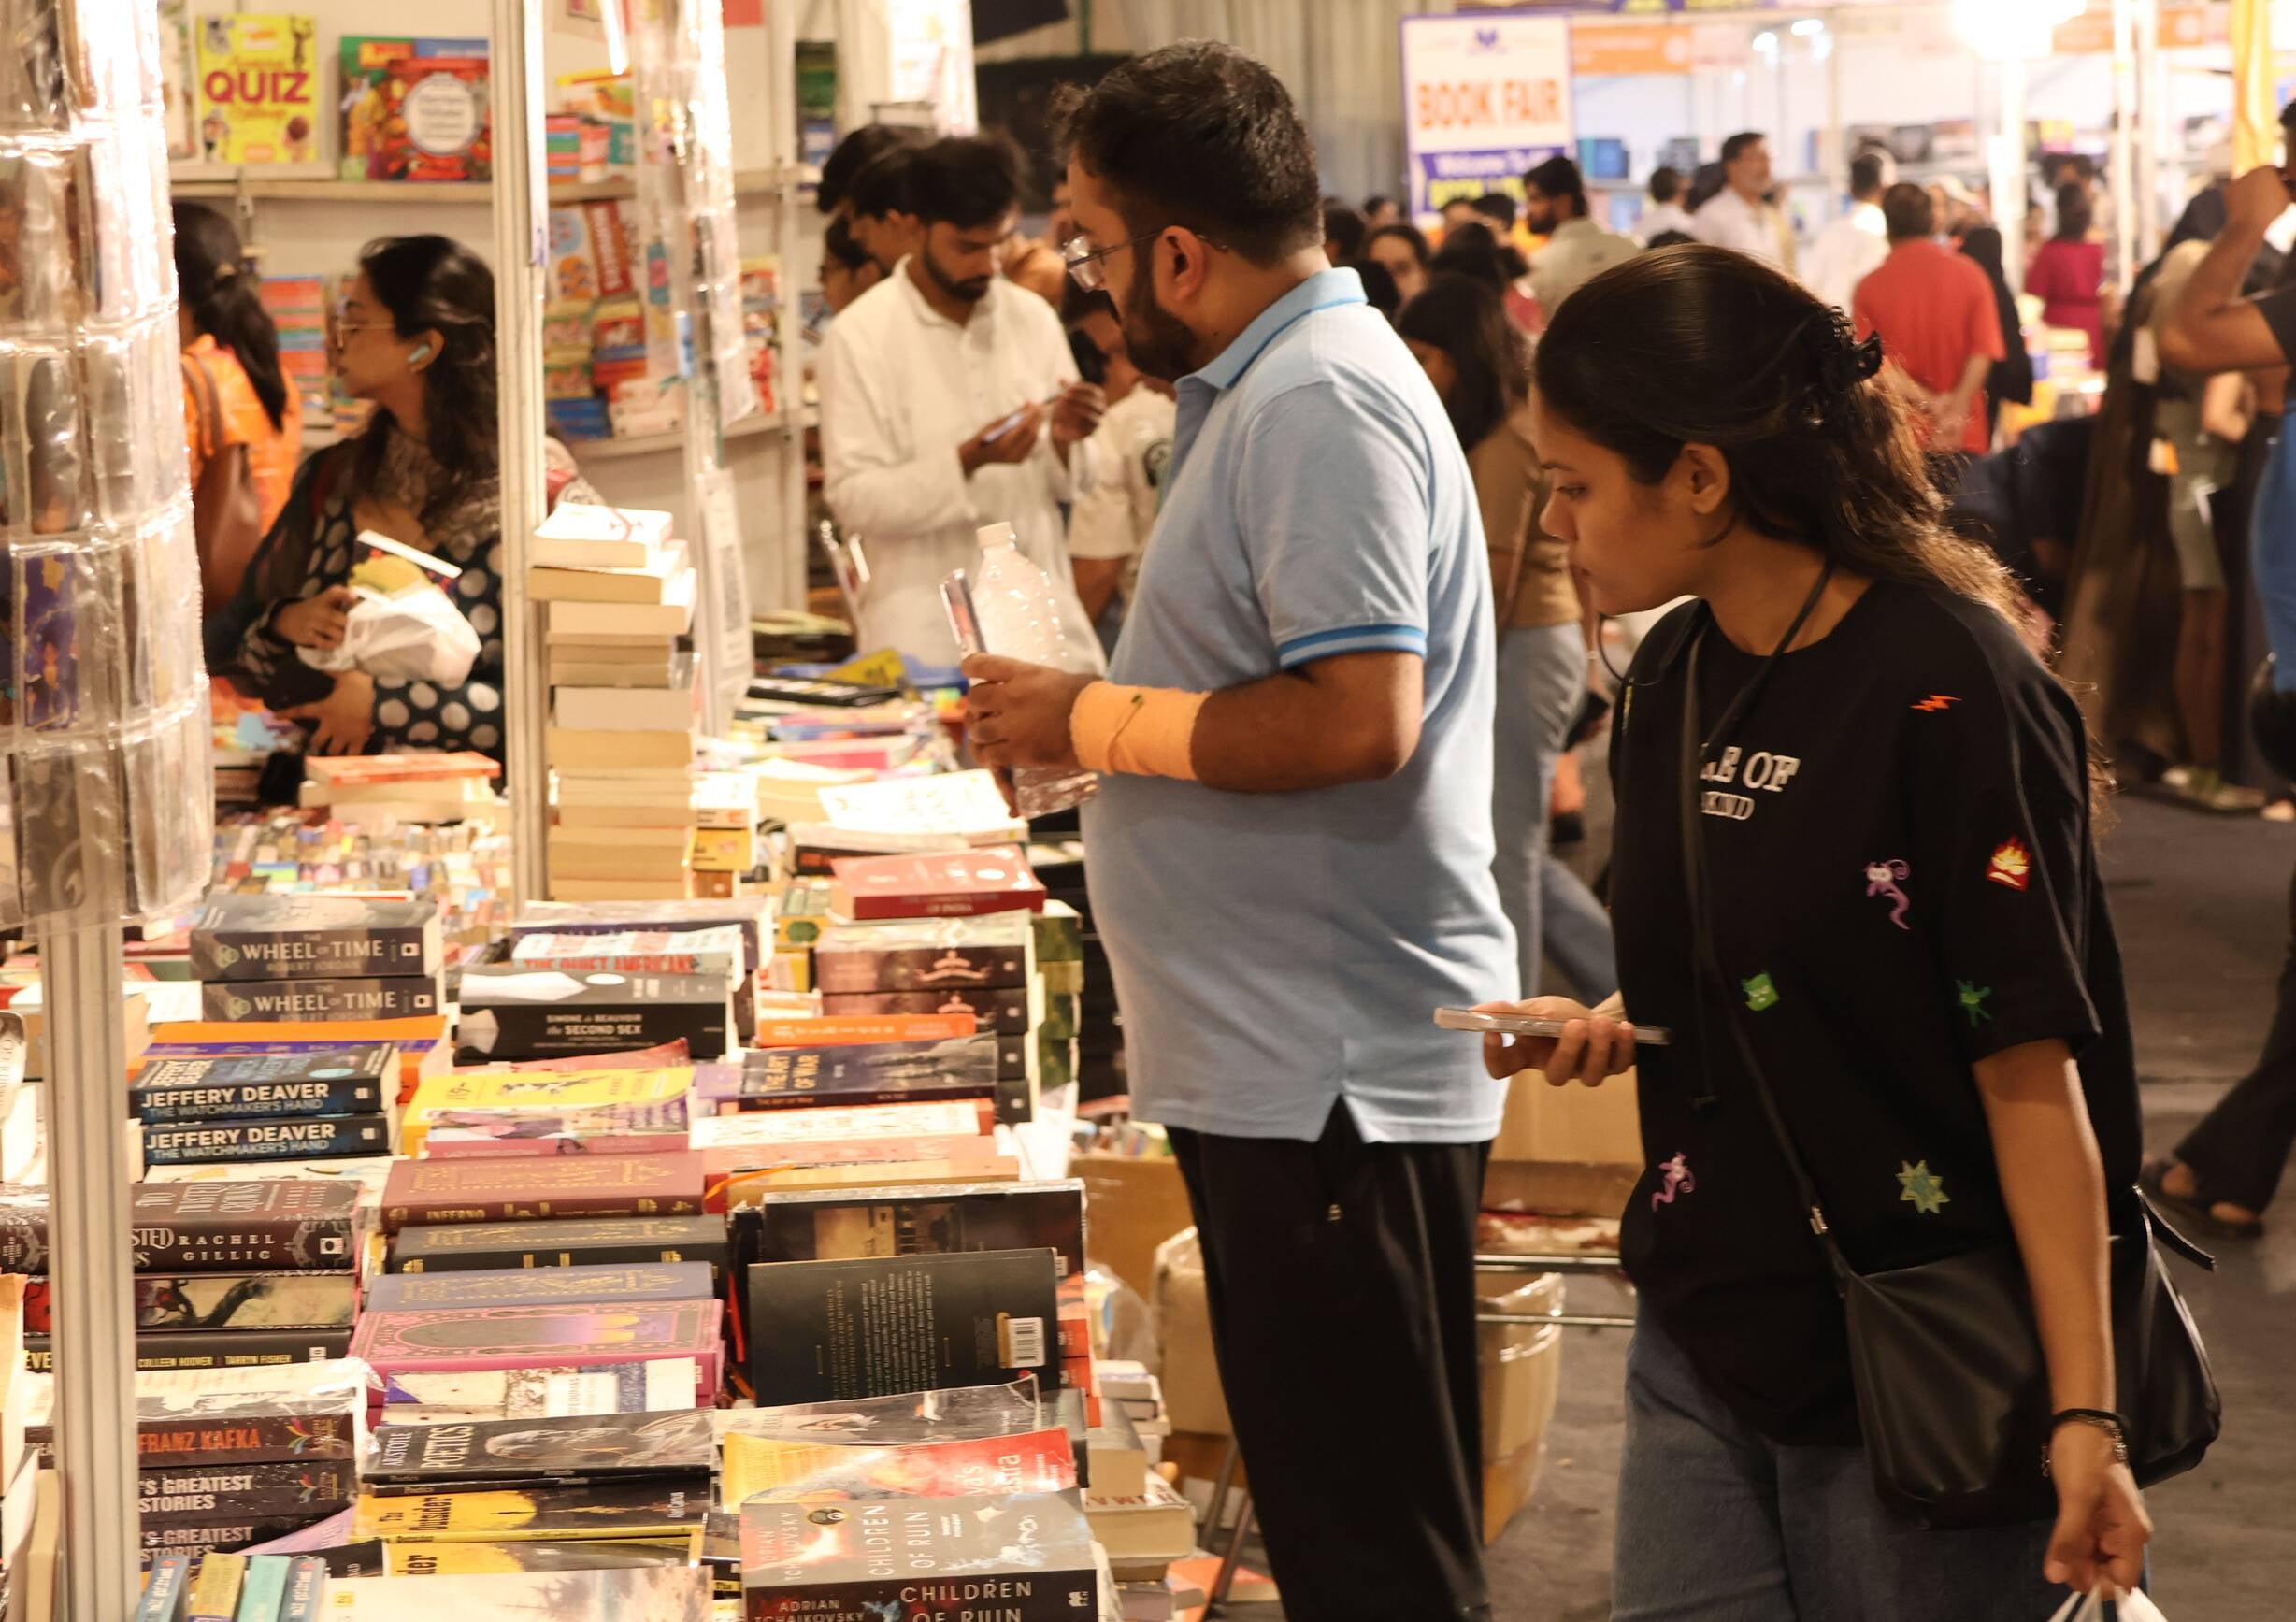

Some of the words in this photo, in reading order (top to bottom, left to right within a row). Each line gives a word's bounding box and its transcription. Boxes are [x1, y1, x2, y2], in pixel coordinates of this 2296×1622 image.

[205, 70, 310, 104] QUIZ
[1417, 81, 1494, 129] BOOK
[1502, 79, 1561, 124] FAIR
[1743, 752, 1801, 792] OF
[242, 942, 316, 960] WHEEL
[330, 940, 384, 958] TIME
[254, 994, 329, 1012] WHEEL
[343, 991, 396, 1009] TIME
[564, 1025, 615, 1035] SECOND
[617, 1025, 642, 1035] SEX
[142, 1087, 235, 1109] JEFFERY
[242, 1083, 329, 1104] DEAVER
[149, 1107, 175, 1118] THE
[178, 1100, 281, 1117] WATCHMAKER'S
[283, 1098, 323, 1111] HAND
[146, 1128, 240, 1150] JEFFERY
[248, 1124, 336, 1144] DEAVER
[154, 1148, 180, 1160] THE
[182, 1141, 288, 1158] WATCHMAKER'S
[290, 1140, 330, 1152] HAND
[179, 1234, 275, 1246] RACHEL
[182, 1250, 272, 1262] GILLIG
[138, 1431, 196, 1454] FRANZ
[200, 1428, 262, 1450] KAFKA
[421, 1425, 476, 1469] POETICS
[162, 1474, 254, 1494] GREATEST
[139, 1495, 216, 1514] STORIES
[408, 1497, 452, 1531] Outsider
[163, 1525, 254, 1545] GREATEST
[904, 1510, 932, 1549] RUIN
[861, 1504, 895, 1577] CHILDREN
[909, 1552, 935, 1570] OF
[900, 1581, 1032, 1604] CHILDREN
[777, 1599, 839, 1614] ADRIAN
[960, 1607, 1022, 1622] RUIN
